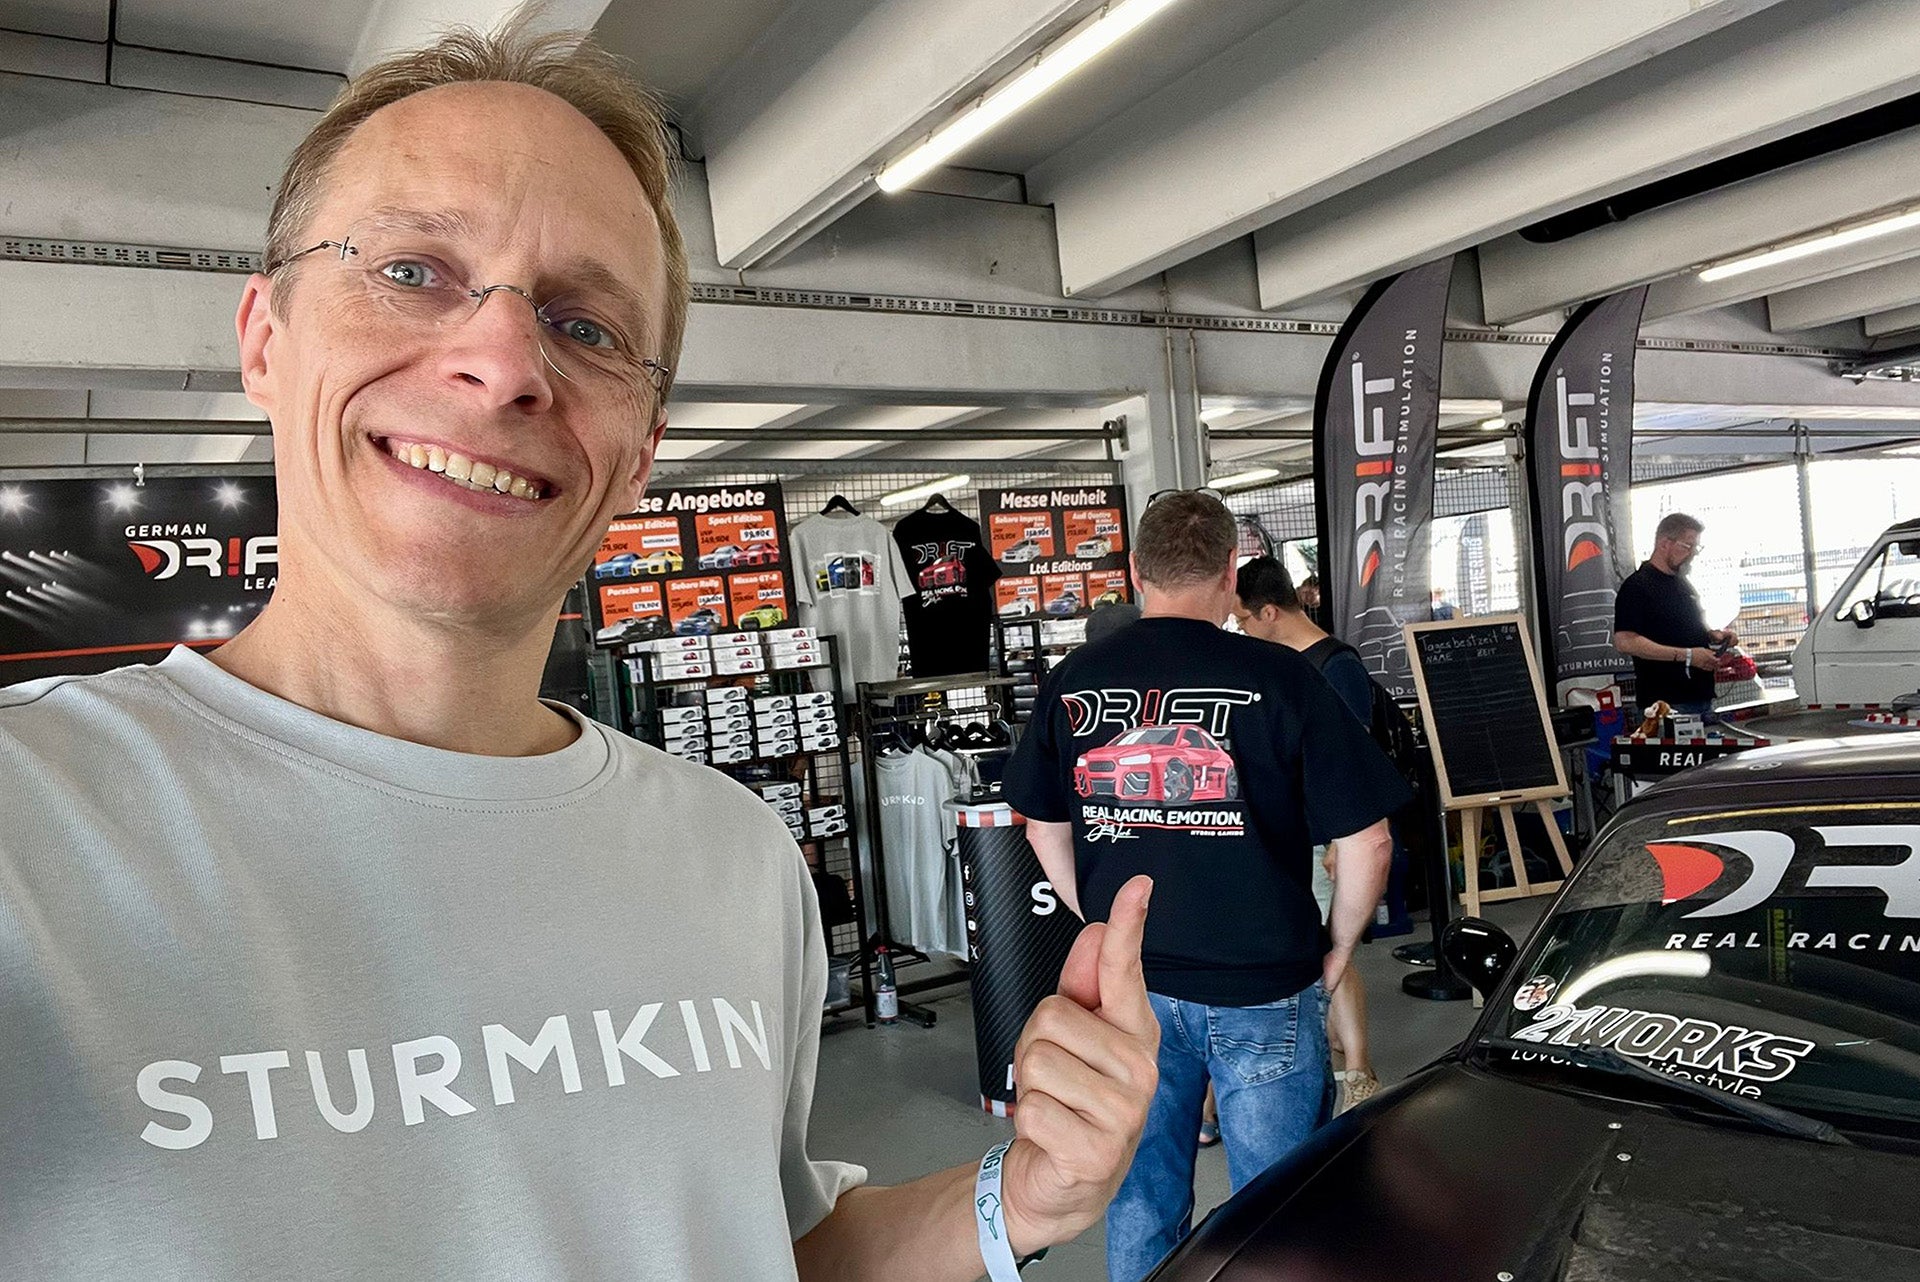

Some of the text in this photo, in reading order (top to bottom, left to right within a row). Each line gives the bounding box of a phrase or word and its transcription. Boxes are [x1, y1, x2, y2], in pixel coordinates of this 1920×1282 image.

[1598, 351, 1613, 462] SIMULATION
[1392, 328, 1418, 598] REAL RACING SIMULATION
[667, 489, 765, 513] Angebote
[1000, 489, 1107, 509] Messe Neuheit
[125, 523, 208, 538] GERMAN
[708, 516, 733, 526] Sport
[1030, 560, 1093, 576] Ltd. Editions
[243, 578, 278, 590] LEA
[1418, 629, 1499, 654] Tagesbestzeit
[1425, 652, 1453, 664] NAME
[1082, 806, 1114, 820] REAL
[1166, 811, 1244, 826] EMOTION.
[1030, 881, 1057, 917] S
[1664, 931, 1920, 952] REAL RACIN
[1510, 1002, 1816, 1083] 21WORKS
[135, 996, 776, 1151] STURMKIN
